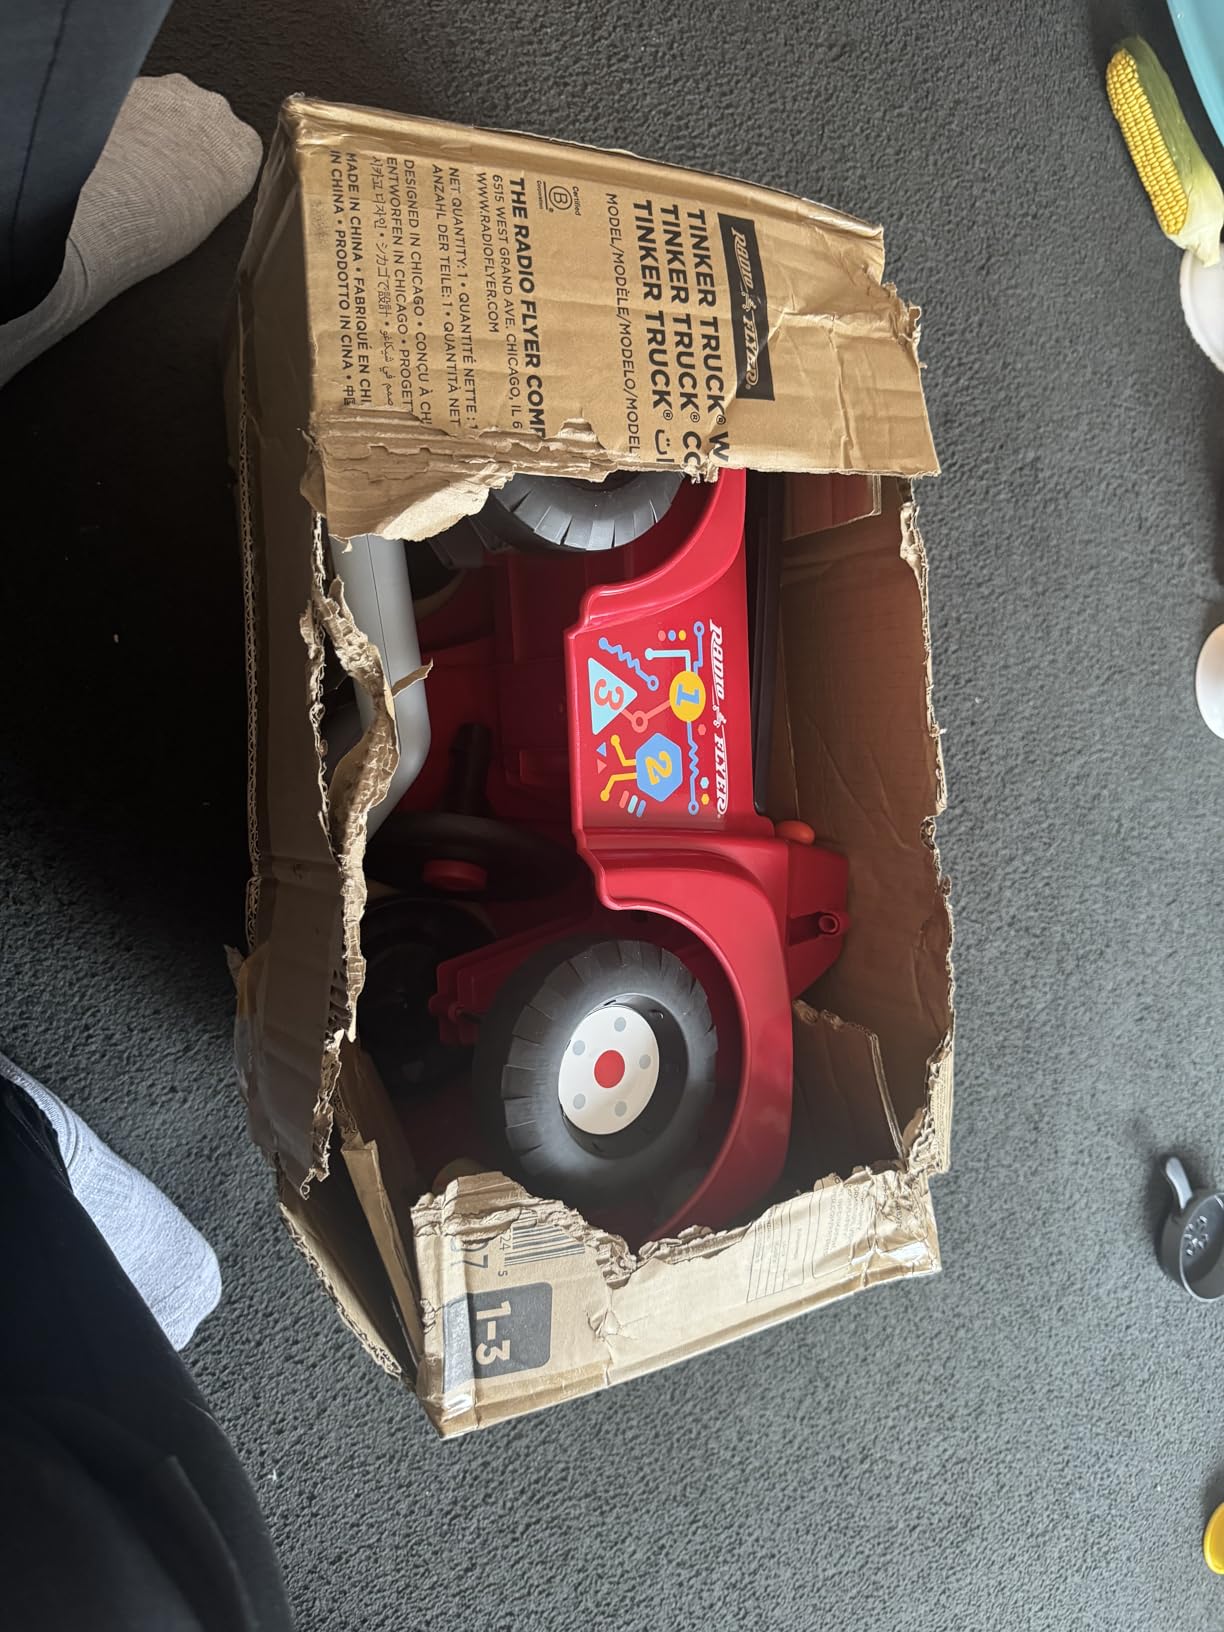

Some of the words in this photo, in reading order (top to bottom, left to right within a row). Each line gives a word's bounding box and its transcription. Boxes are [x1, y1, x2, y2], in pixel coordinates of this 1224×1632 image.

[330, 150, 342, 164] IN
[346, 153, 359, 193] MADE
[370, 156, 385, 190] 시카고
[331, 168, 345, 214] CHINA
[386, 157, 404, 246] ENTWORFEN
[404, 159, 419, 228] DESIGNED
[432, 164, 447, 220] ANZAHL
[448, 167, 461, 194] NET
[492, 174, 505, 203] 6515
[509, 177, 528, 219] THE
[349, 197, 360, 211] IN
[372, 193, 388, 229] 디자인
[495, 206, 509, 244] WEST
[350, 216, 363, 262] CHINA
[409, 232, 421, 247] IN
[437, 224, 450, 251] DER
[451, 197, 468, 269] QUANTITY:
[475, 172, 500, 333] WWW.RADIOFLYER.COM
[633, 199, 662, 301] TINKER
[660, 204, 690, 304] TINKER
[334, 229, 350, 310] PRODOTTO
[376, 242, 392, 318] シカゴで設計
[393, 250, 405, 264] IN
[439, 256, 452, 298] TEILE:
[499, 247, 513, 295] GRAND
[513, 224, 535, 294] RADIO
[686, 208, 717, 307] TINKER
[394, 269, 408, 335] CHICAGO
[410, 251, 425, 317] CHICAGO
[731, 226, 754, 292] RADIO
[743, 314, 759, 386] FLYER
[339, 315, 351, 330] IN
[353, 277, 373, 350] FABRIQUÉ
[458, 292, 477, 364] QUANTITÉ
[503, 298, 516, 329] AVE.
[520, 299, 541, 368] FLYER
[340, 334, 354, 370] CINA
[358, 354, 370, 374] EN
[415, 331, 429, 382] CONÇU
[443, 321, 462, 393] QUANTITÀ
[506, 333, 521, 400] CHICAGO,
[644, 310, 674, 421] TRUCK®
[672, 313, 701, 423] TRUCK®
[699, 316, 727, 426] TRUCK®
[418, 386, 433, 397] À
[449, 398, 461, 427] NET
[463, 368, 477, 413] NETTE
[511, 405, 522, 417] IL
[512, 421, 524, 429] 6
[709, 431, 729, 462] W
[709, 619, 726, 700] RADIO
[594, 678, 624, 711] 3
[675, 683, 700, 707] 1
[645, 751, 673, 785] 2
[714, 730, 728, 815] FLYER
